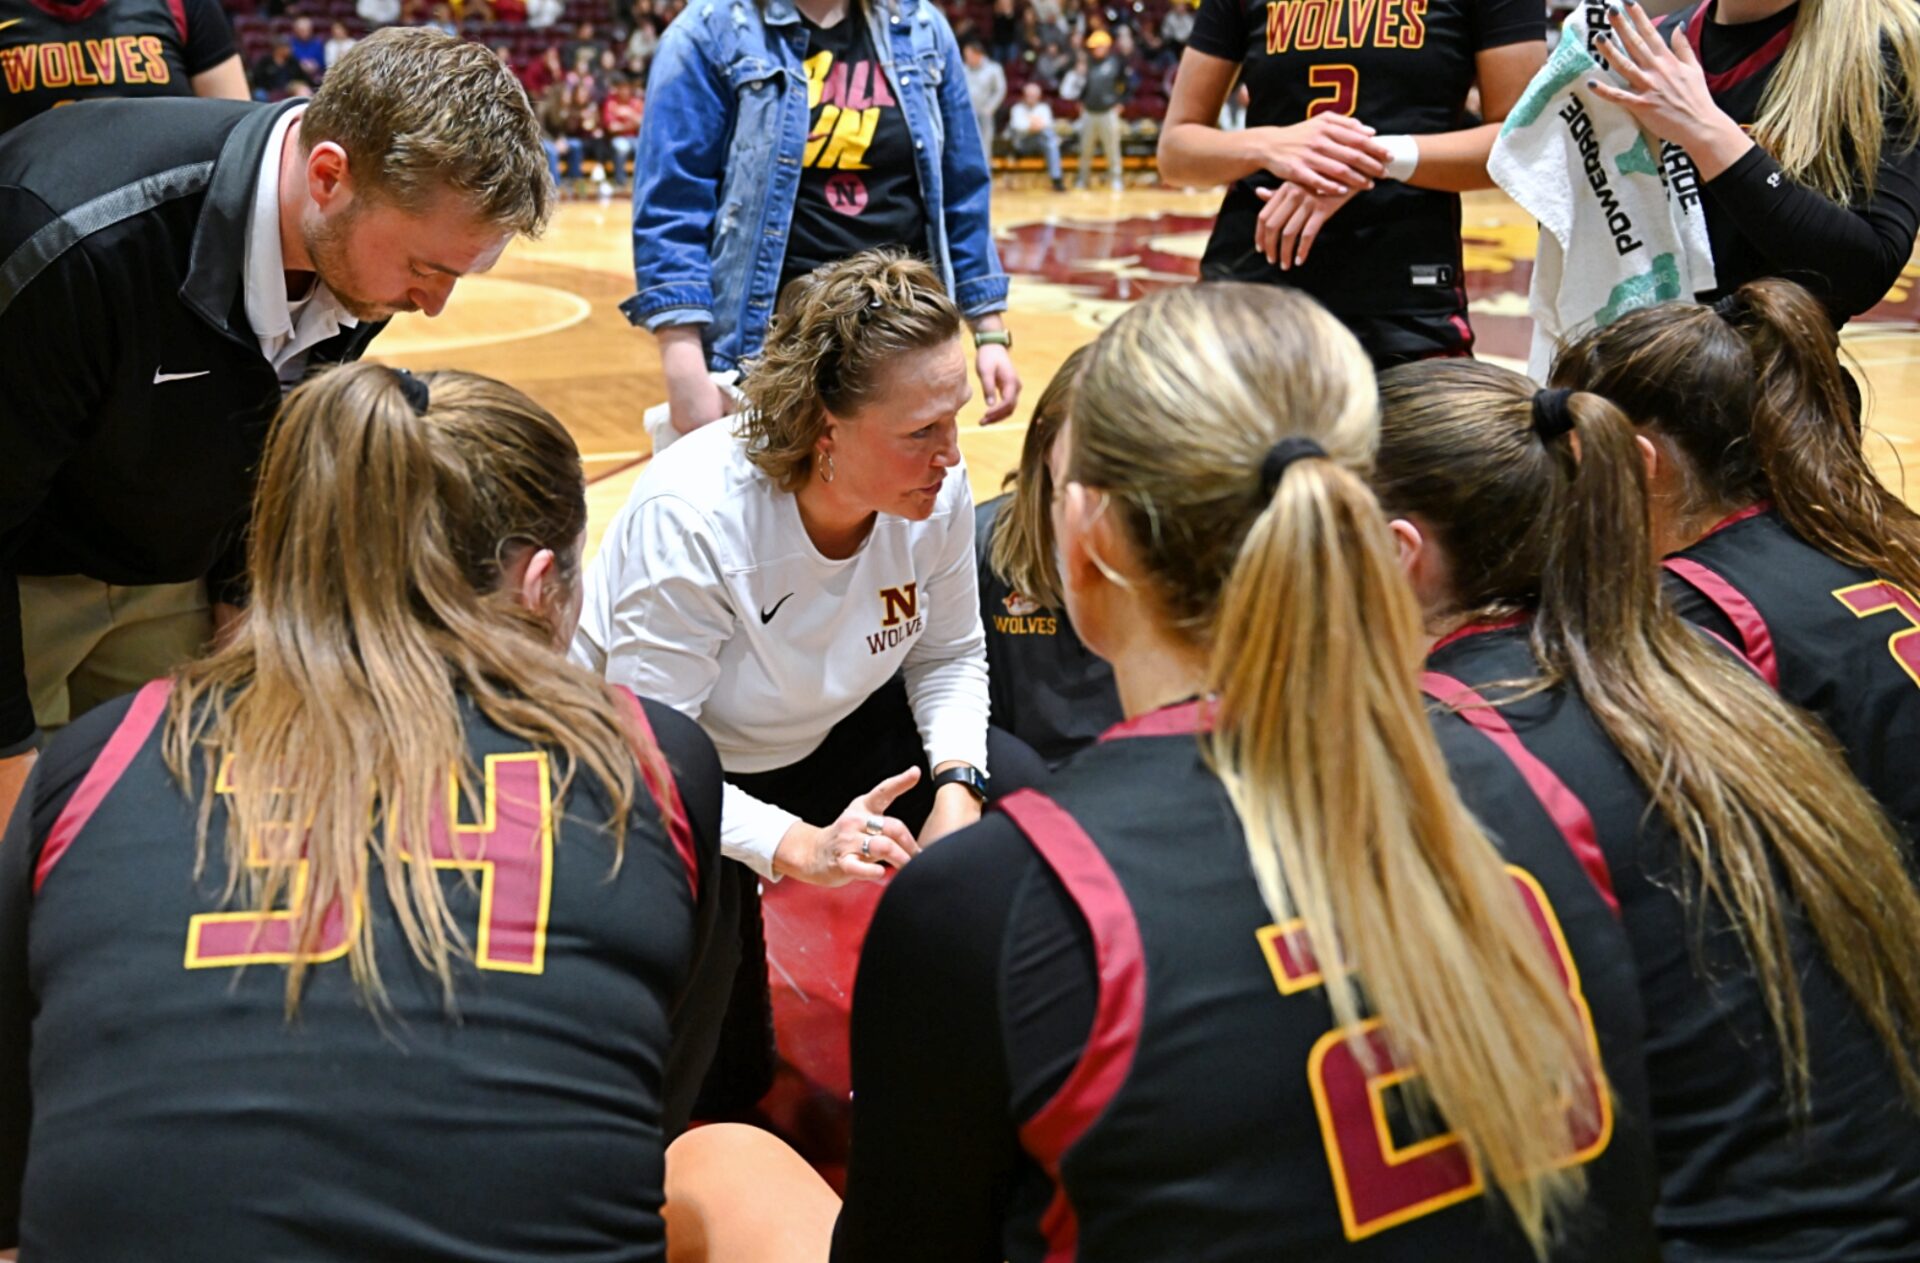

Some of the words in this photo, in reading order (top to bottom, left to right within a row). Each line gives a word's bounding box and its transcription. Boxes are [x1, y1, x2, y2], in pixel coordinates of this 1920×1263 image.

[1266, 0, 1428, 55] WOLVES
[1, 36, 170, 94] WOLVES
[1306, 63, 1359, 120] 2
[832, 181, 861, 207] N
[880, 582, 918, 627] N
[993, 615, 1057, 636] WOLVES
[184, 751, 553, 975] 34
